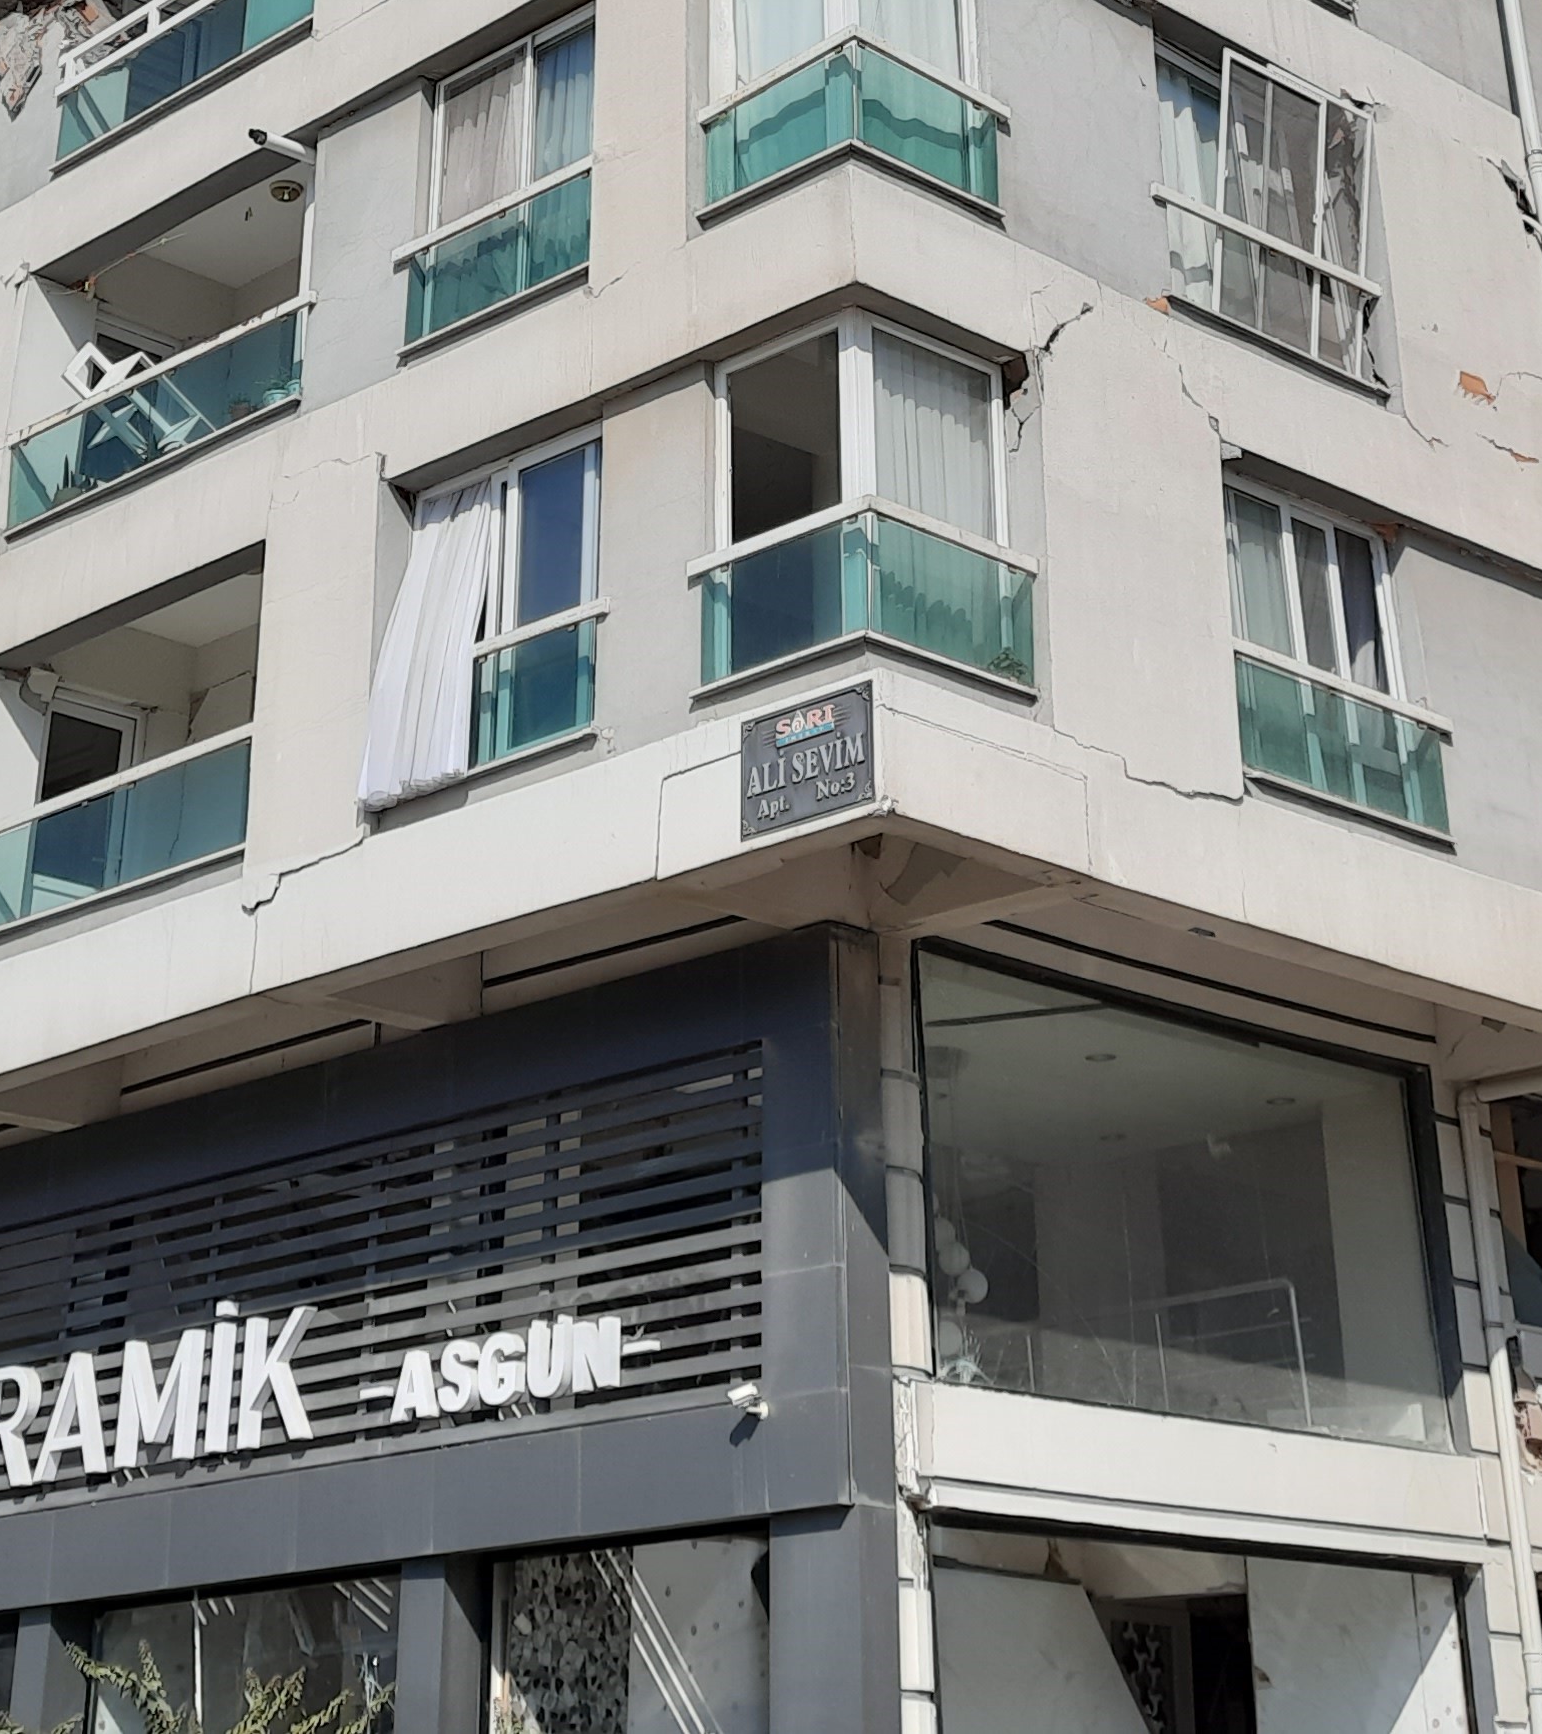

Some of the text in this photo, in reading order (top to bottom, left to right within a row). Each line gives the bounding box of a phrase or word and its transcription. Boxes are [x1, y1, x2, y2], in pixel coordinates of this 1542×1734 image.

[747, 732, 865, 797] ALİ SEVİM
[758, 772, 855, 819] Apt. No:3
